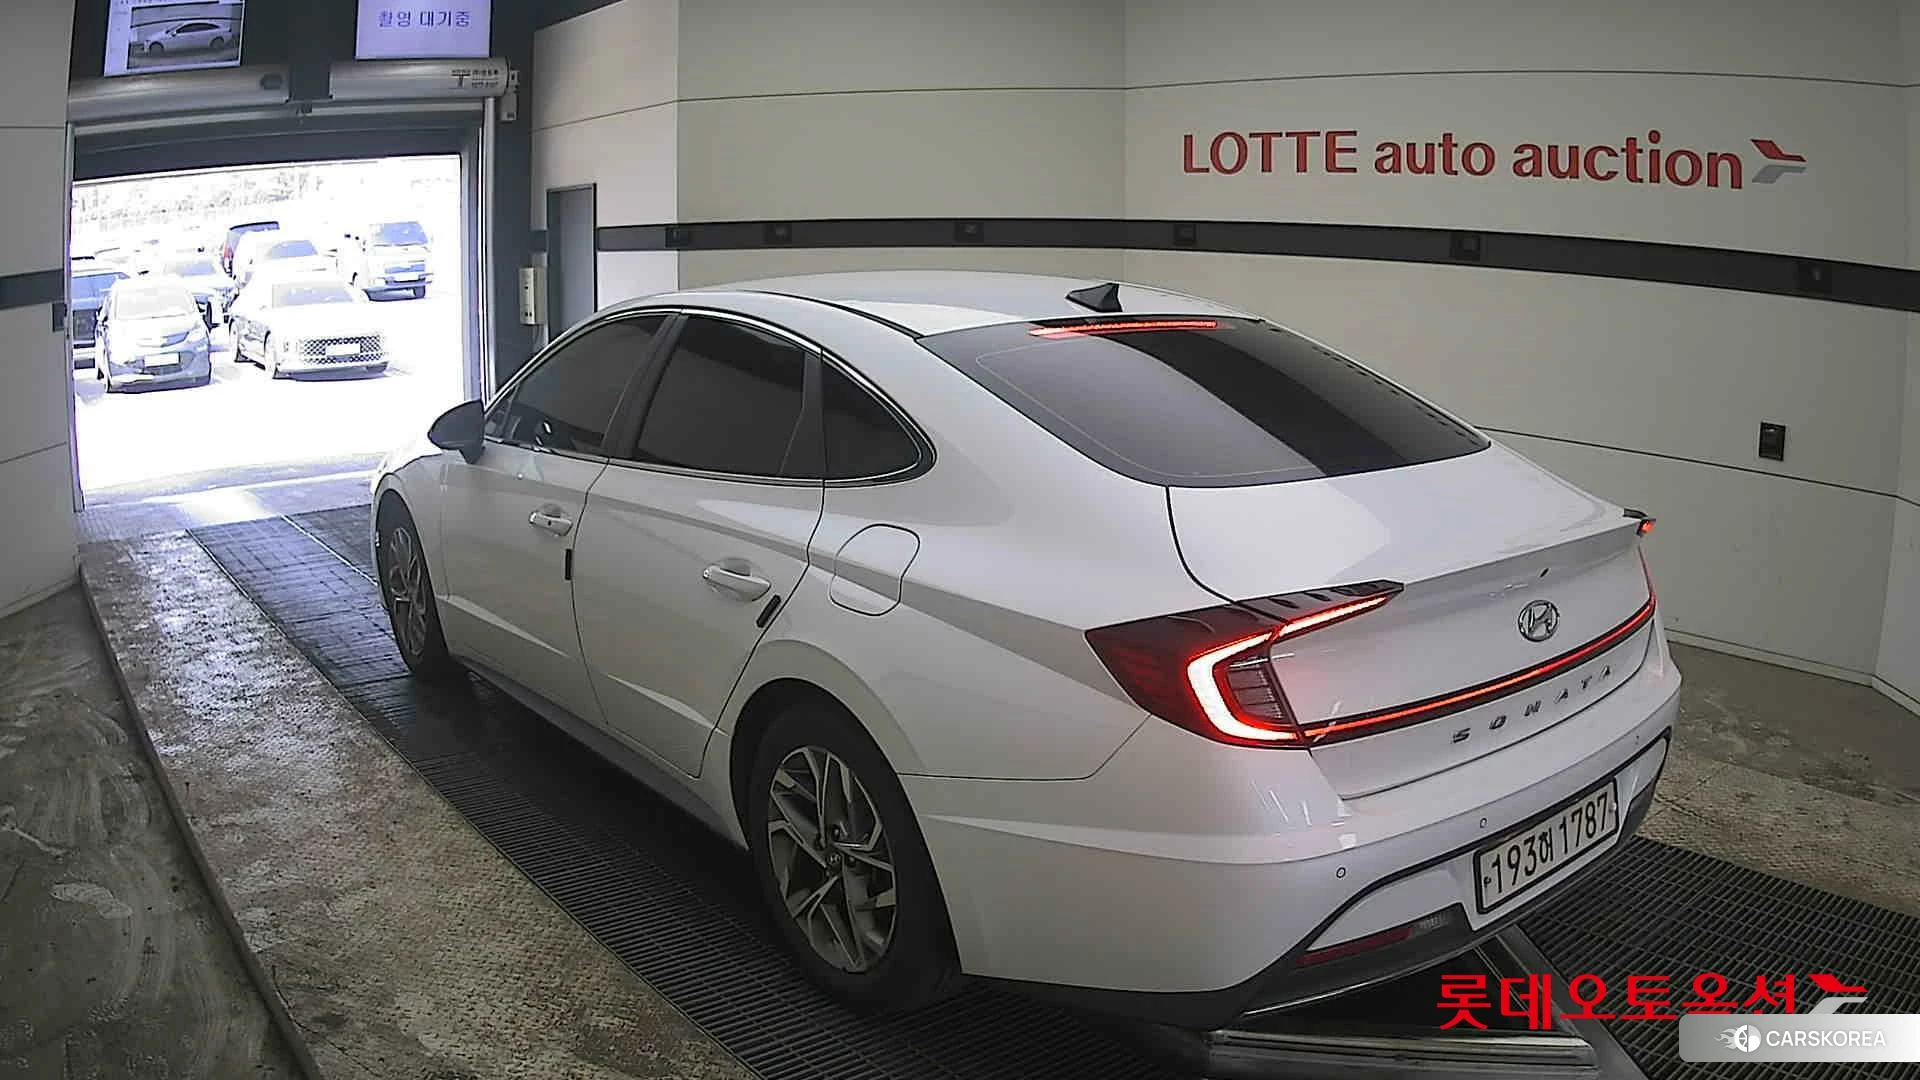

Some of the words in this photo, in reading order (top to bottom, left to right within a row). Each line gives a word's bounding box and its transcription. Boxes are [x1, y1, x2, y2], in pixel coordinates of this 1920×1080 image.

[419, 9, 471, 28] 대기중
[1183, 129, 1359, 175] LOTTE
[1374, 132, 1496, 177] auto
[1511, 130, 1744, 190] auction
[1451, 664, 1613, 745] SONATA
